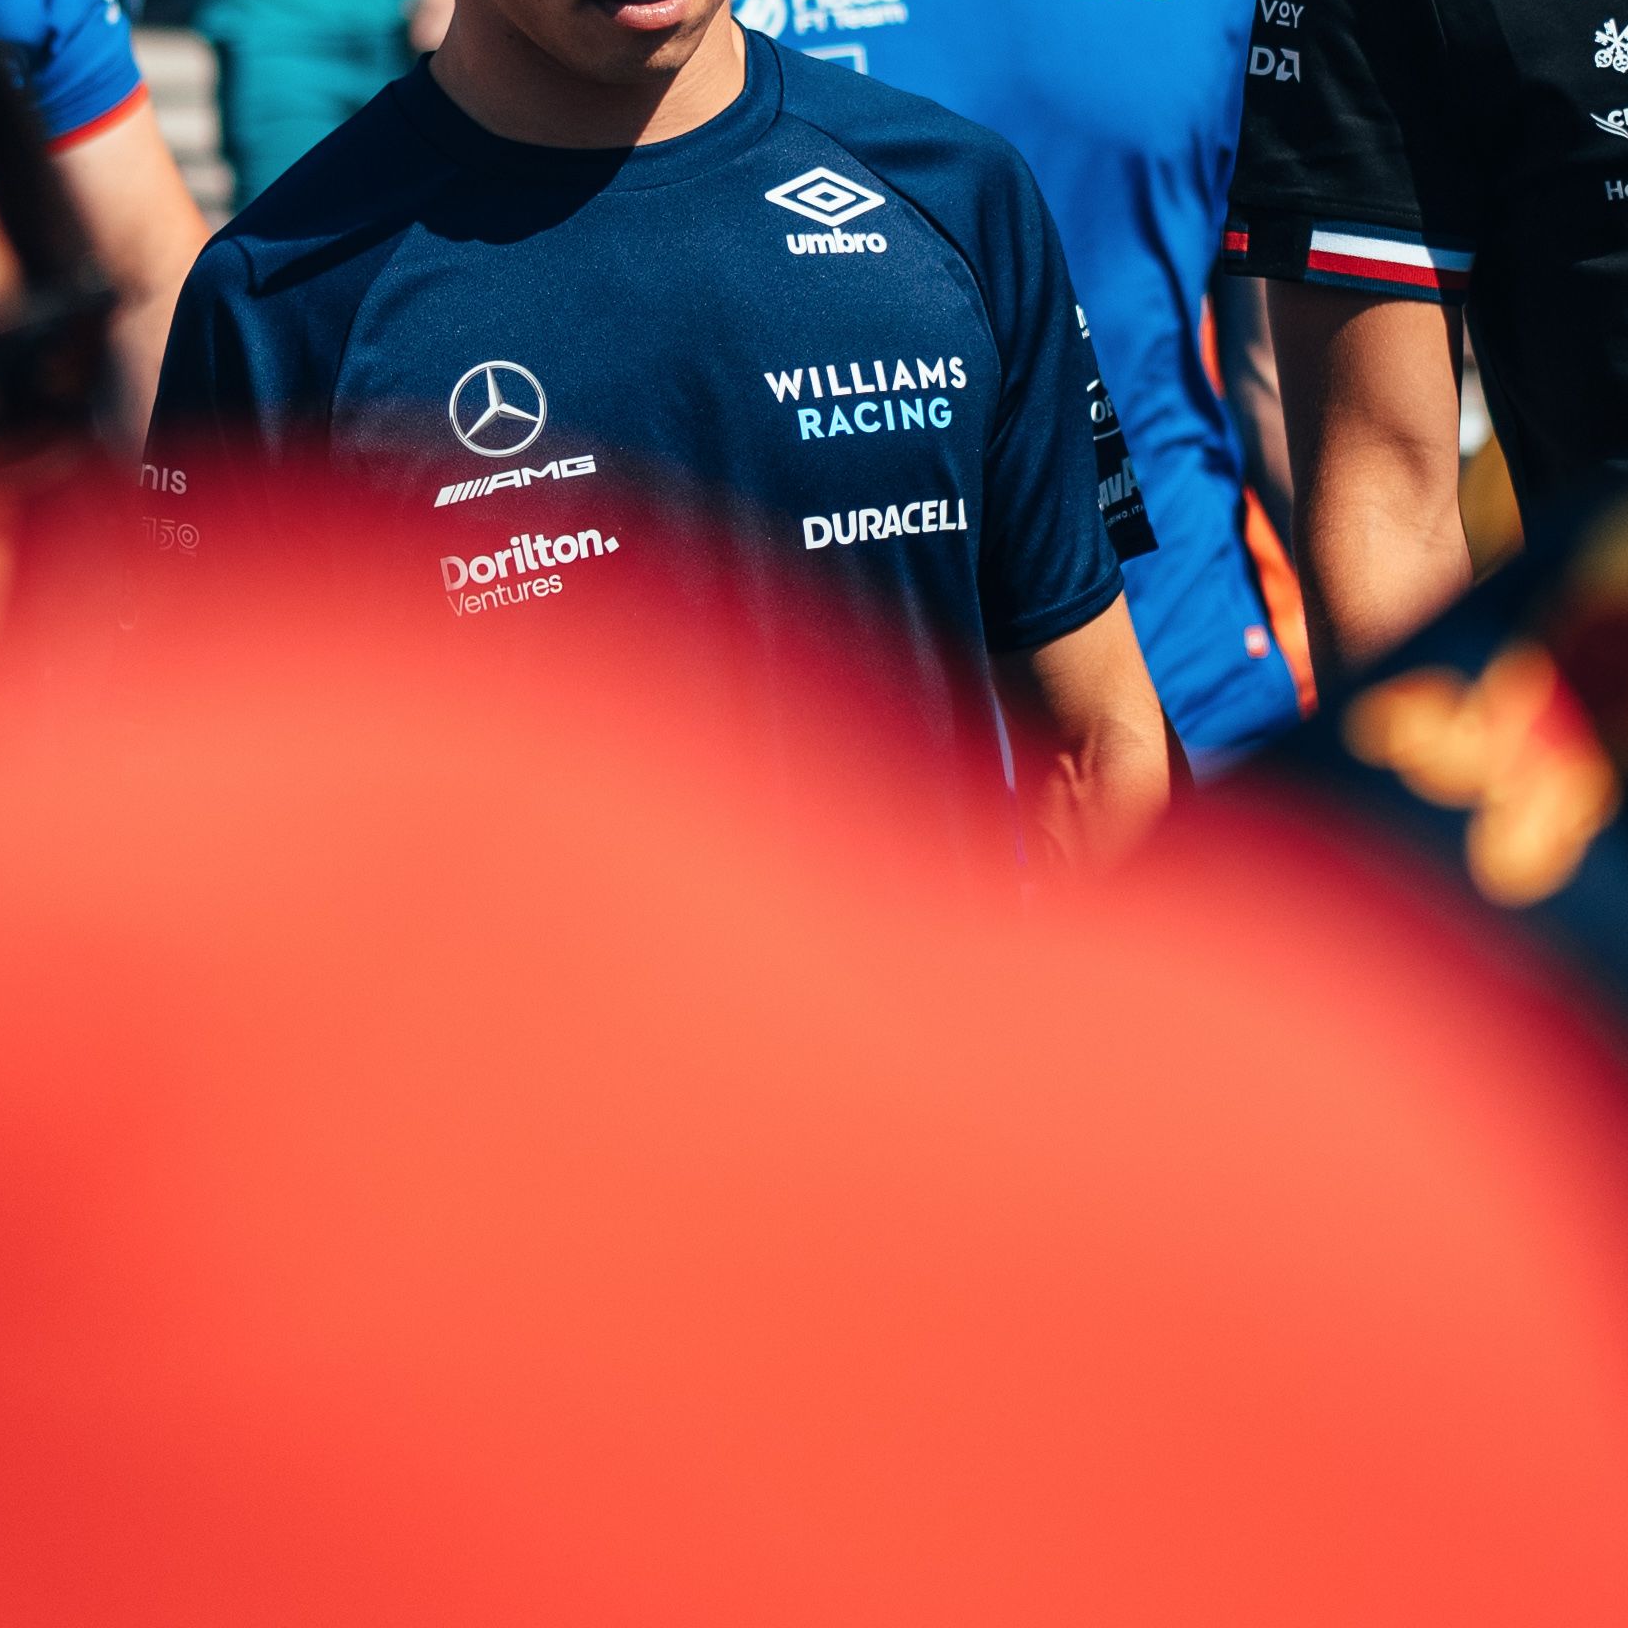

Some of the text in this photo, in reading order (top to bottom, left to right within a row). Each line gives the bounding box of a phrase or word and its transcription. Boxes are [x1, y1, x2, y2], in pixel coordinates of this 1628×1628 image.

[785, 227, 888, 255] umbro
[763, 356, 968, 404] WILLIAMS
[796, 396, 953, 441] RACING
[447, 573, 564, 618] Ventures
